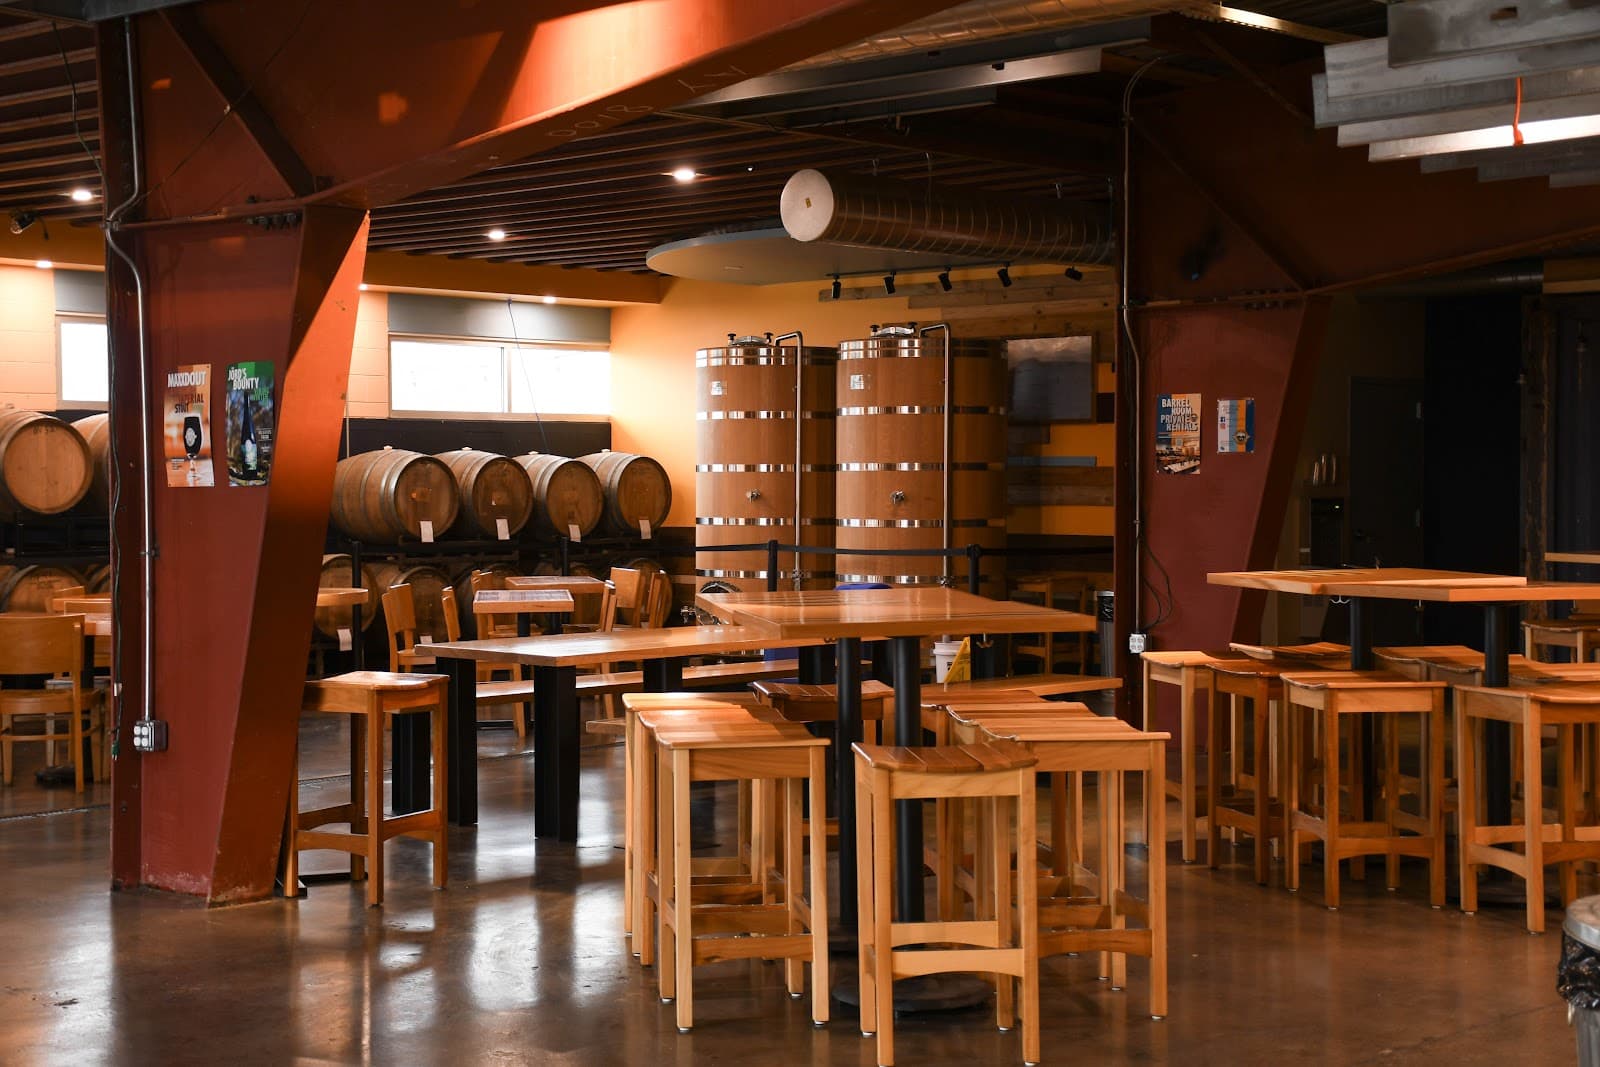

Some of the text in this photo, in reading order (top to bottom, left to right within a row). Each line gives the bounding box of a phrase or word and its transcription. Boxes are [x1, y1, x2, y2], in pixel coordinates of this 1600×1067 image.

[232, 377, 260, 390] BOUNTY
[1161, 399, 1191, 408] BARREL
[1171, 407, 1192, 416] ROOM
[1160, 414, 1191, 424] PRIVATE
